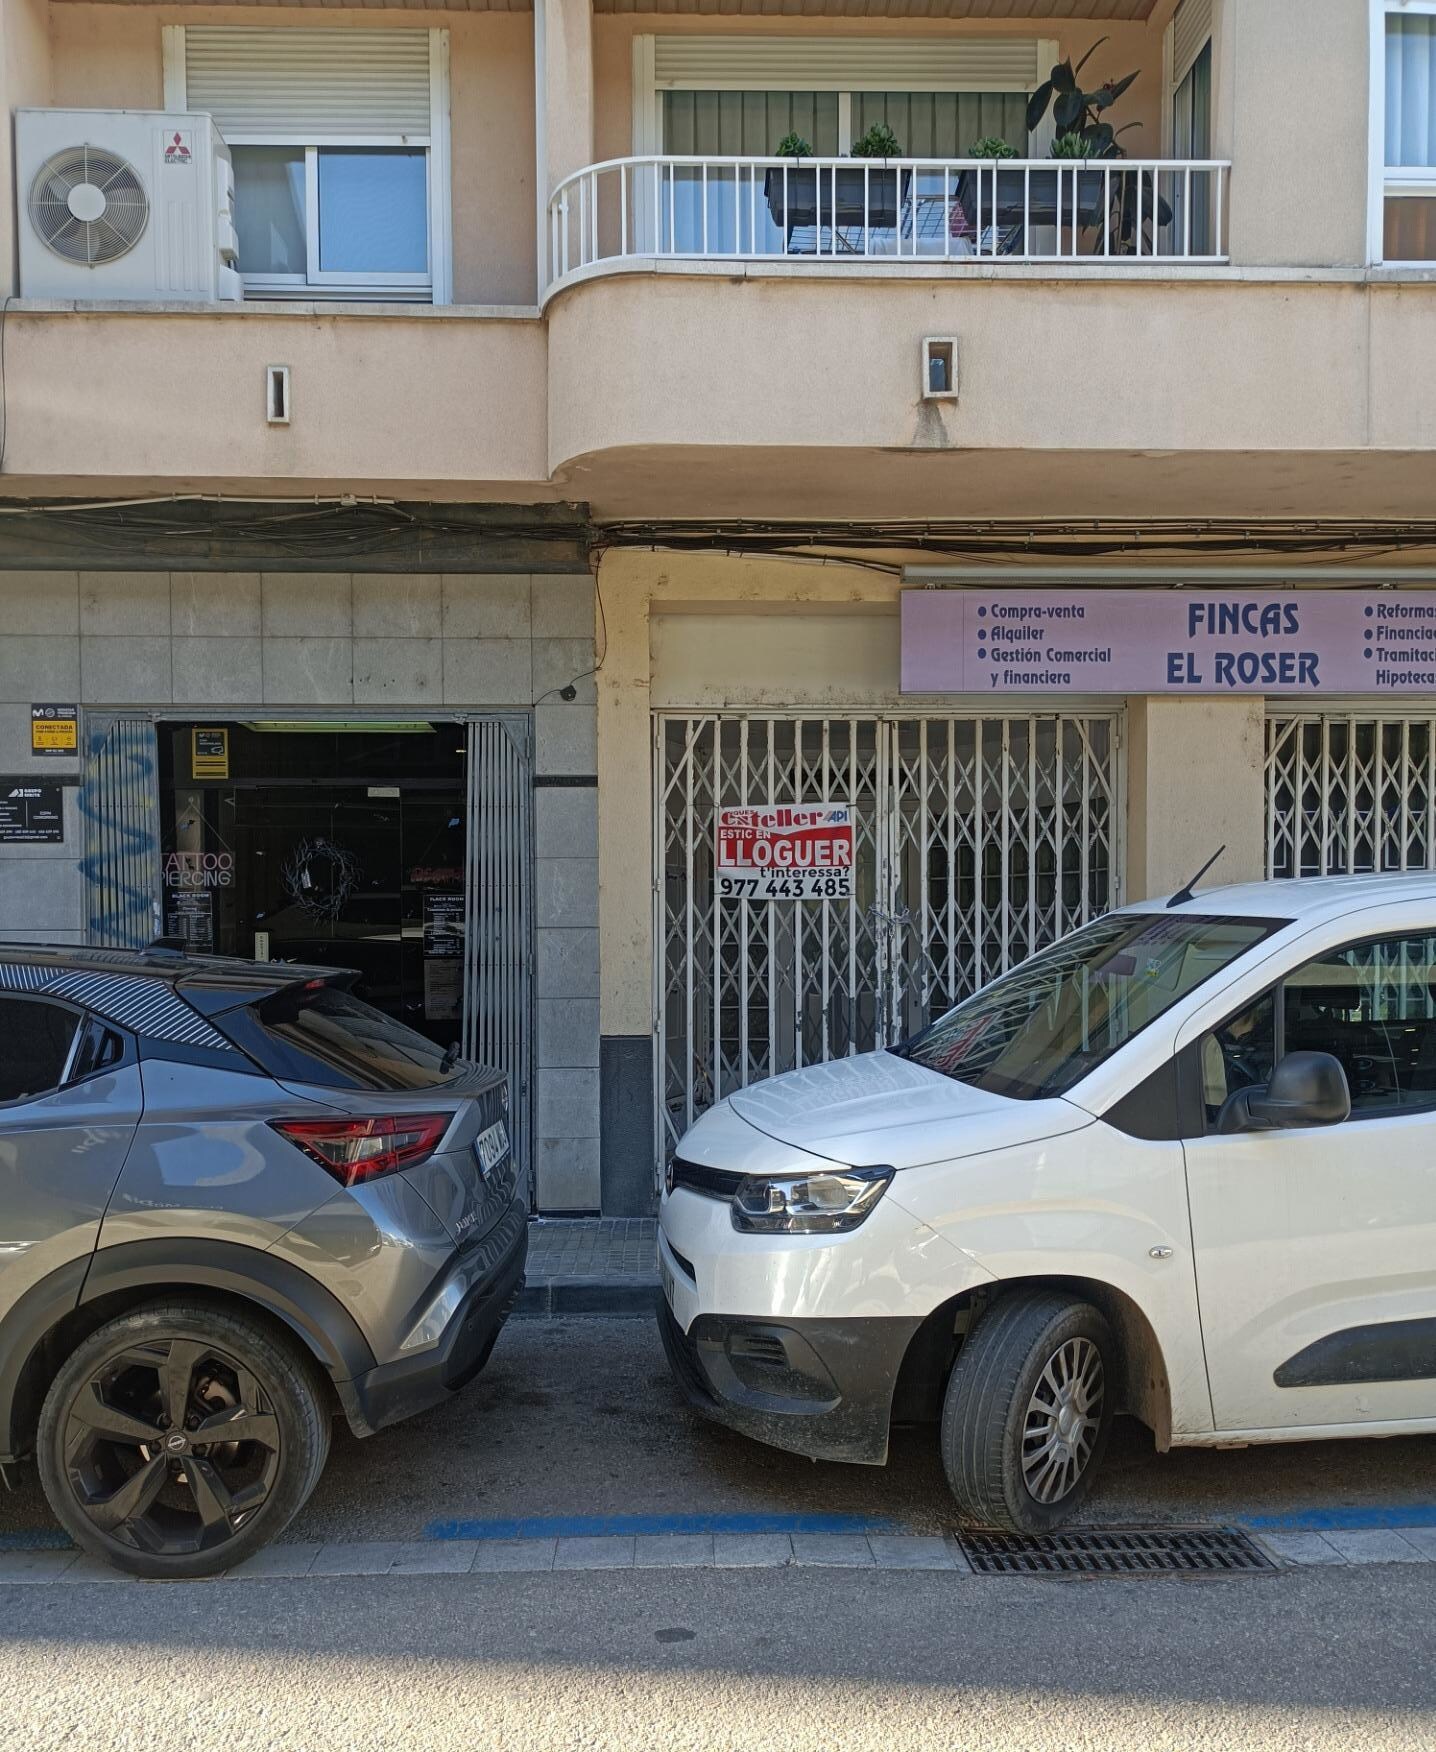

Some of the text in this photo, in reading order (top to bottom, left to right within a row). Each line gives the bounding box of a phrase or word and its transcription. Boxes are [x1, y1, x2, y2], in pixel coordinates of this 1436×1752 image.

[991, 604, 1085, 621] Compra-venta
[1377, 603, 1436, 619] Reforma
[1189, 603, 1299, 638] FINCAS
[990, 625, 1044, 643] Alquiler
[991, 648, 1111, 662] Gestión Comercial
[991, 669, 1071, 687] y financiera
[1167, 652, 1320, 687] EL ROSER
[1376, 669, 1436, 687] Hipoteca
[720, 830, 771, 839] ESTIC EN
[720, 839, 851, 867] LLOGUER
[760, 865, 850, 878] t'interessa?
[720, 878, 850, 897] 977 443 485
